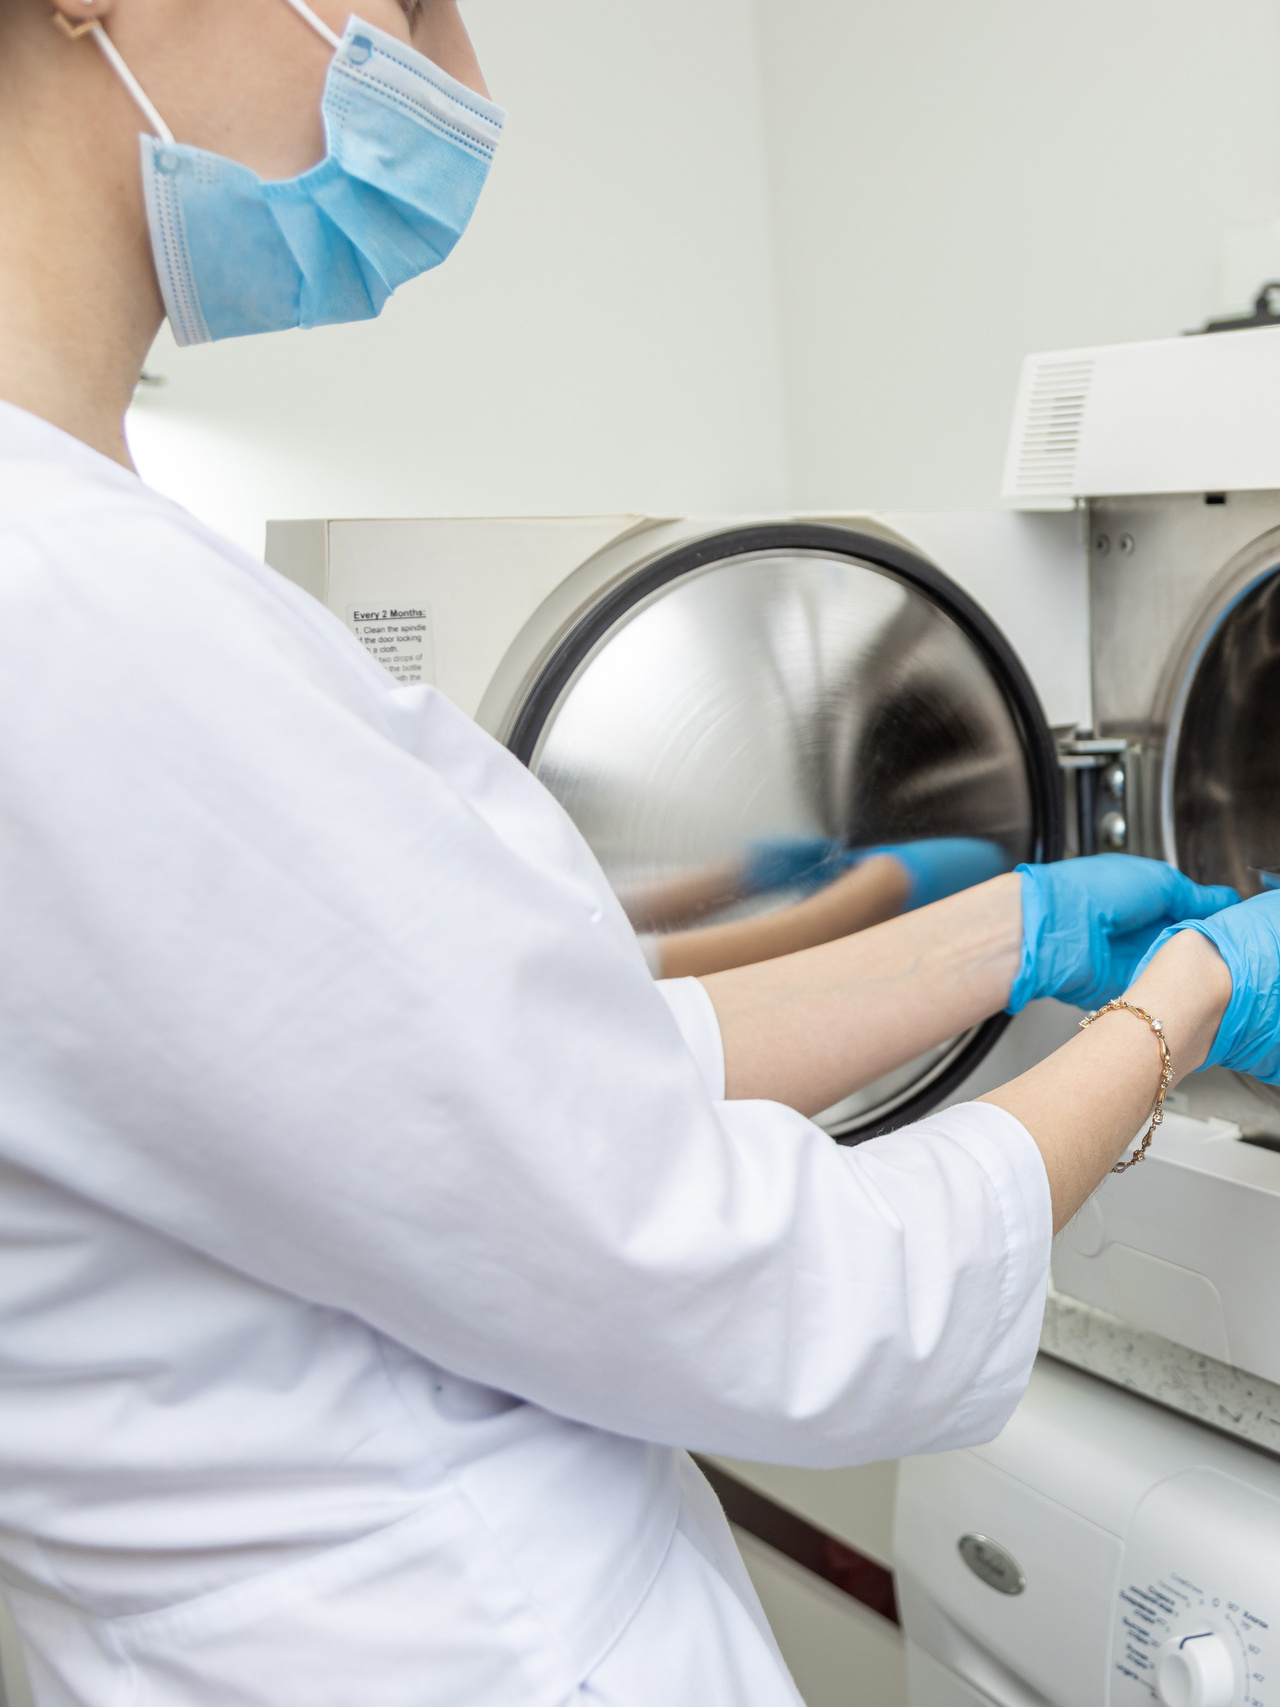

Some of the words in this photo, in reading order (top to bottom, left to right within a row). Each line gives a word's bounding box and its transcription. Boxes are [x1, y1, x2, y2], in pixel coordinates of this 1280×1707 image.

[353, 611, 380, 620] Every
[382, 610, 387, 618] 2
[363, 626, 386, 634] Clean
[387, 624, 399, 632] the
[401, 623, 426, 632] spindle
[364, 636, 377, 644] the
[378, 634, 395, 643] door
[396, 634, 422, 643] locking
[393, 654, 413, 663] drops
[415, 652, 423, 661] of
[389, 664, 400, 672] the
